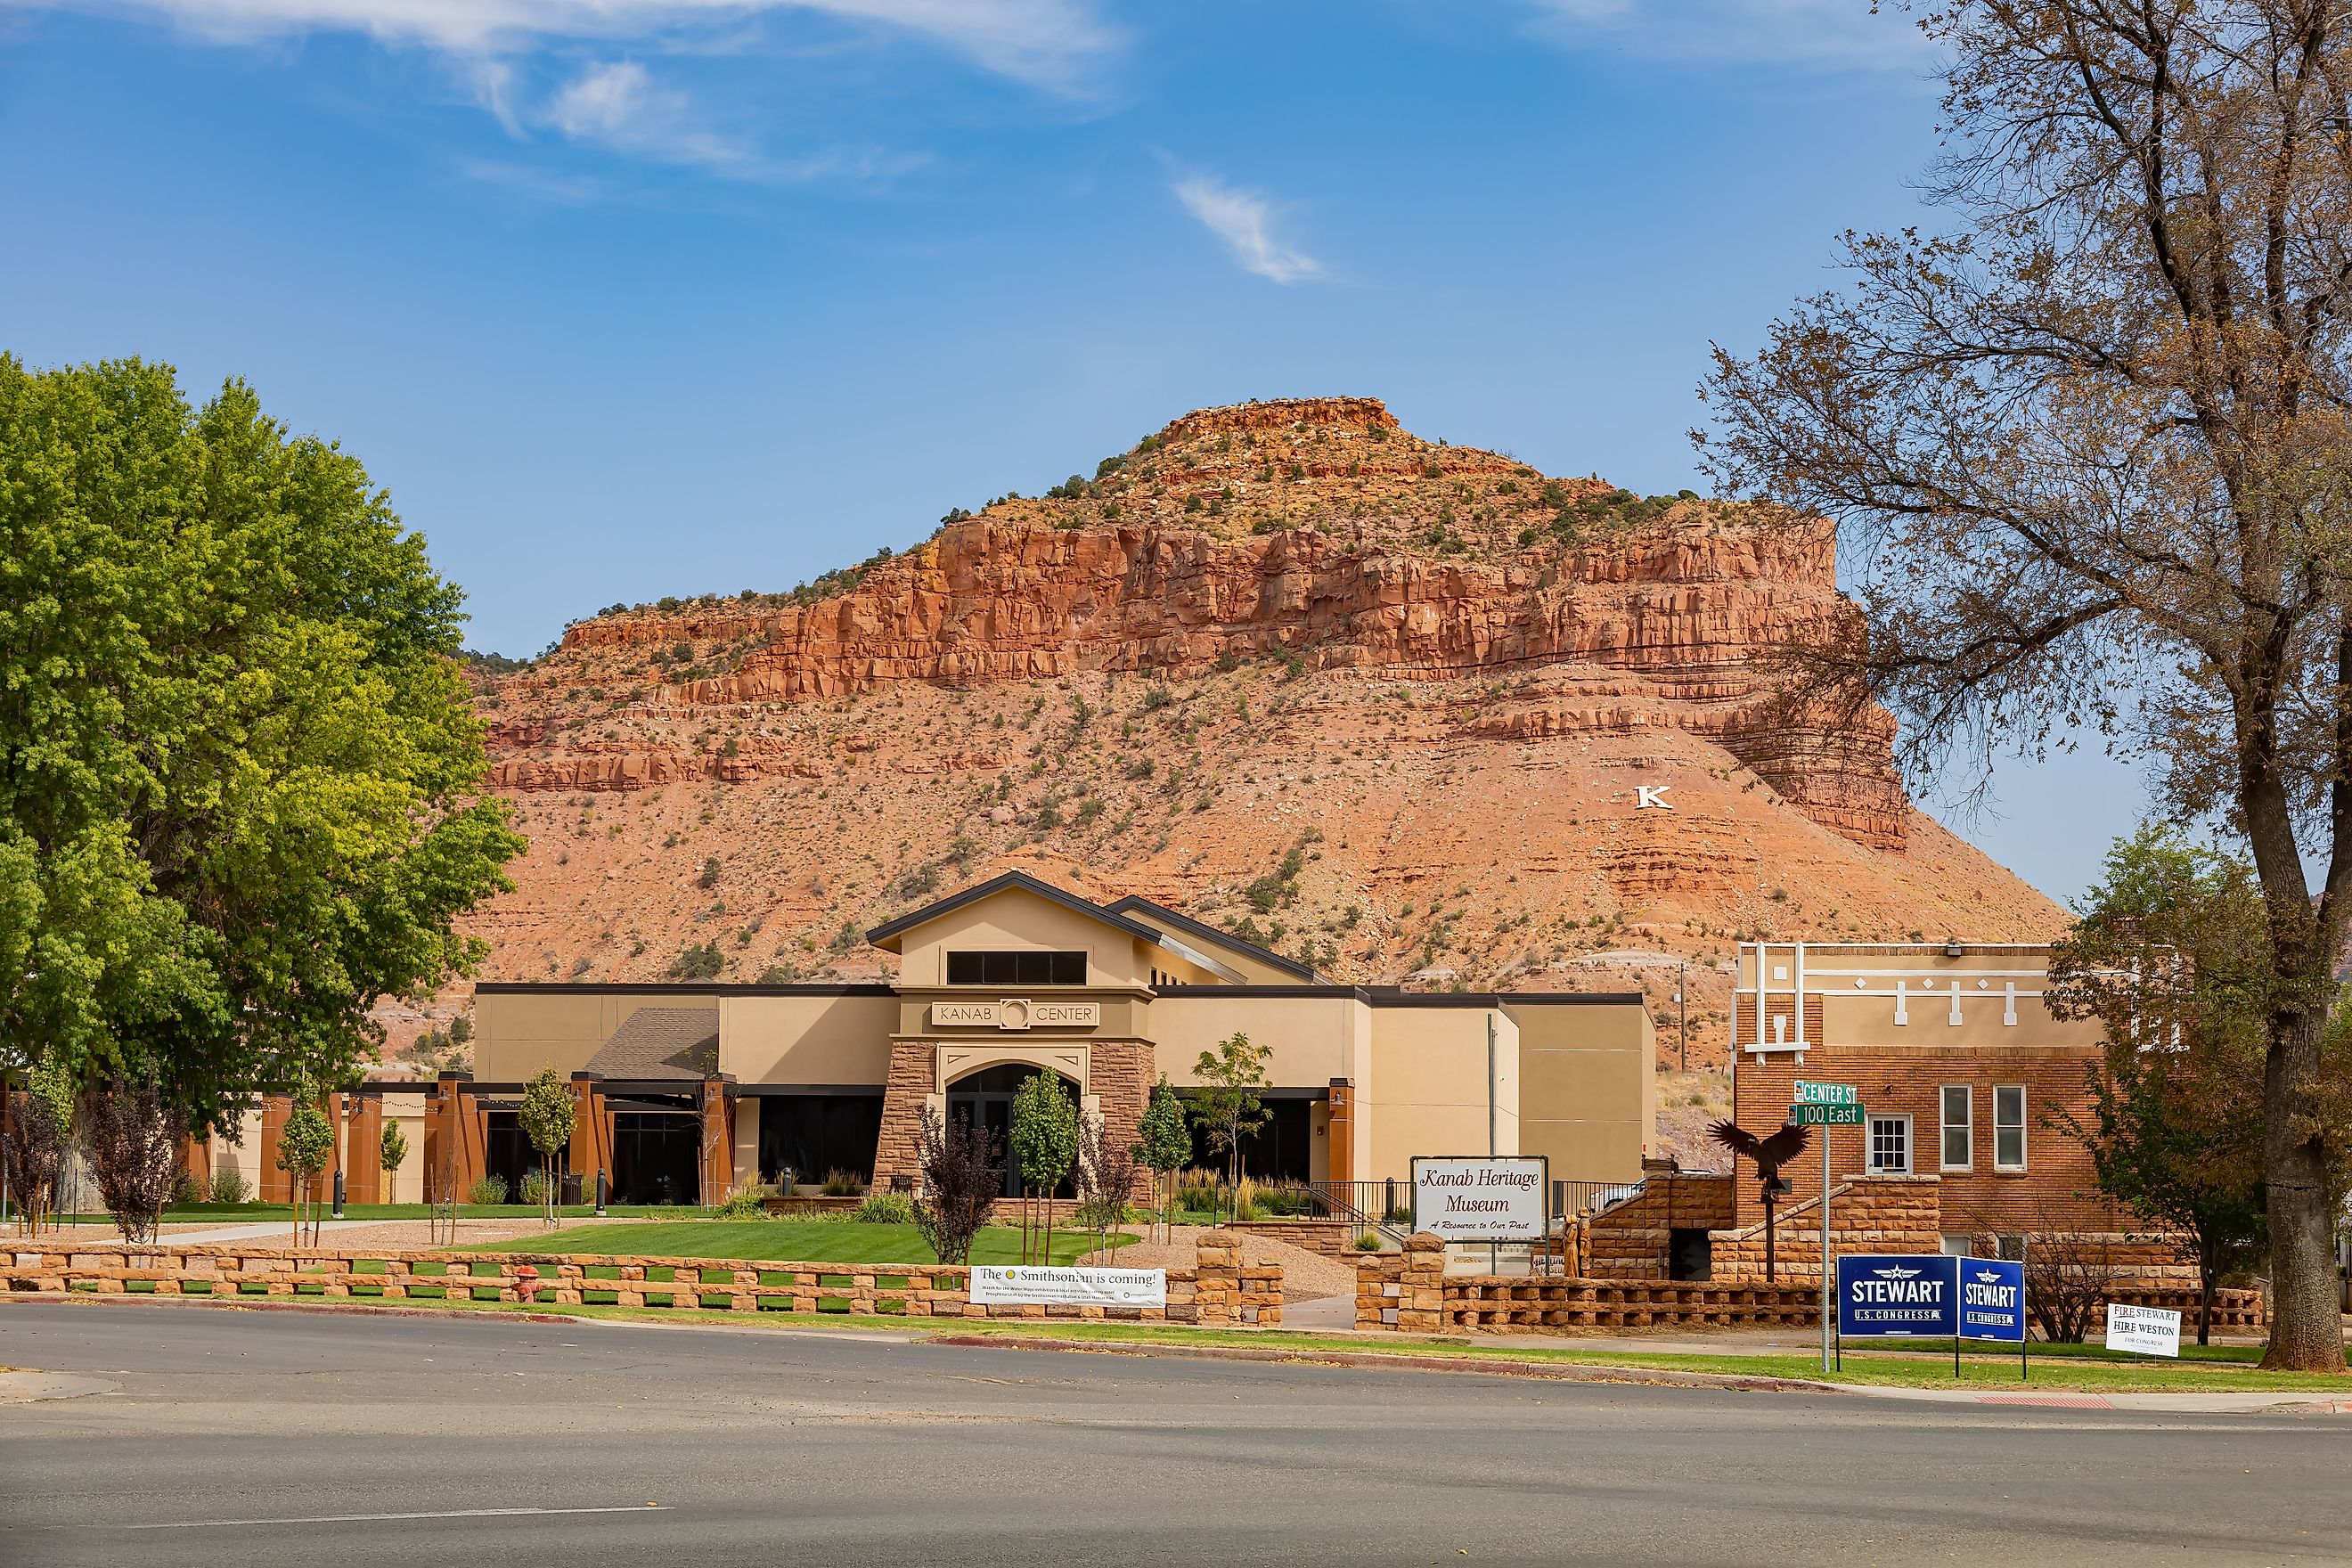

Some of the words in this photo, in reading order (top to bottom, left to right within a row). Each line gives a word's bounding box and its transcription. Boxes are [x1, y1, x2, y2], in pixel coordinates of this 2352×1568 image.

[1634, 786, 1673, 809] K
[941, 1007, 992, 1020] KANAB
[1036, 1008, 1092, 1021] CENTER
[1804, 1083, 1842, 1103] CENTER
[1845, 1087, 1857, 1104] ST
[1804, 1106, 1825, 1123] 100
[1829, 1106, 1857, 1123] East
[1419, 1169, 1474, 1187] Kanab
[1477, 1168, 1539, 1191] Heritage
[1445, 1195, 1509, 1213] Museum
[1429, 1221, 1439, 1229] A
[1441, 1221, 1476, 1229] Resource
[1479, 1221, 1487, 1229] to
[1490, 1221, 1506, 1229] Our
[1508, 1221, 1530, 1229] Past
[981, 1268, 1001, 1279] The
[1021, 1270, 1093, 1283] Smithsonian
[1097, 1273, 1106, 1284] is
[1109, 1273, 1156, 1288] coming!
[1851, 1280, 1944, 1303] STEWART
[1965, 1282, 2017, 1308] STEWART
[1854, 1311, 1874, 1319] U.S.
[1875, 1311, 1930, 1319] CONGRESS
[1966, 1312, 1977, 1321] U.S.
[2114, 1306, 2135, 1316] FIRE
[2136, 1309, 2176, 1320] STEWART
[2114, 1321, 2136, 1332] HIRE
[2138, 1323, 2175, 1335] WESTON
